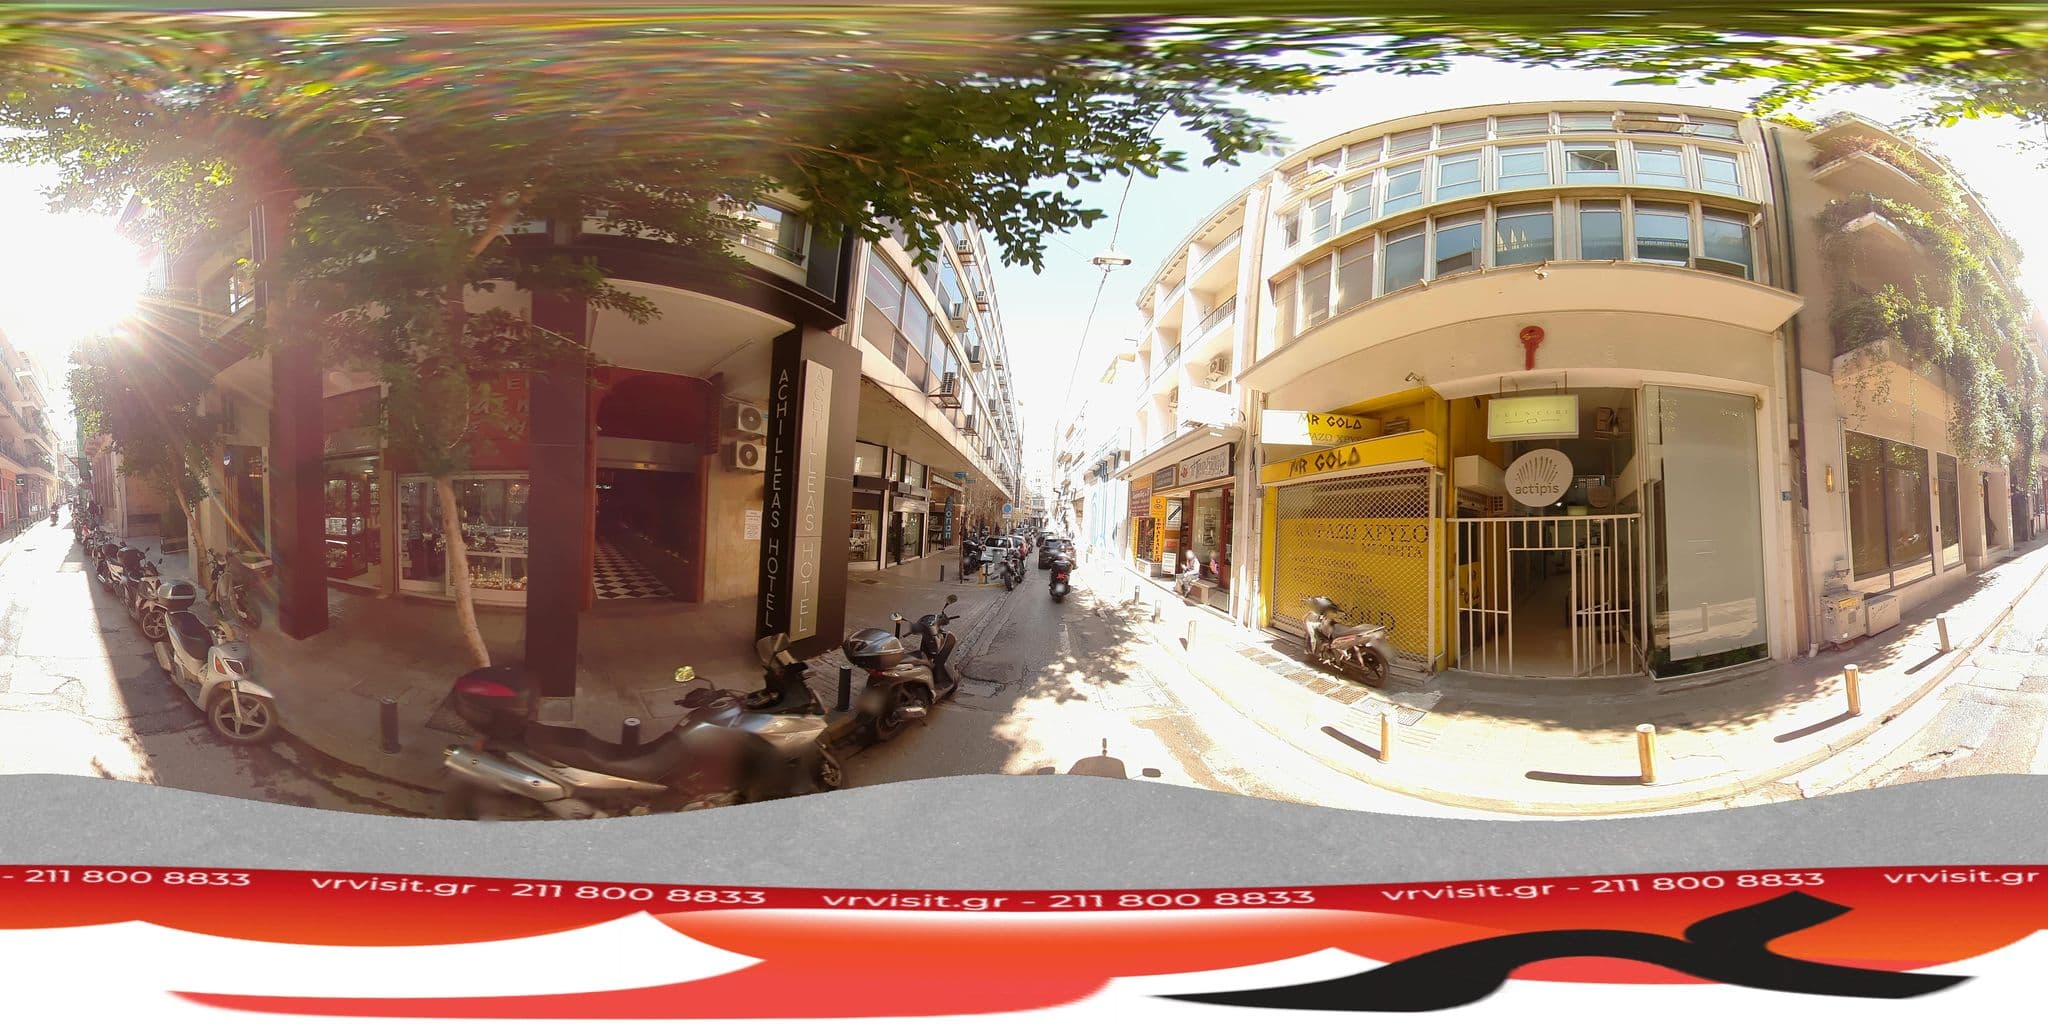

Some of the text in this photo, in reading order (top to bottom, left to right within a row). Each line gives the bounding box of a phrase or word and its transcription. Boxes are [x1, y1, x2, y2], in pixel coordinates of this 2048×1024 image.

[1289, 458, 1308, 477] MR
[765, 369, 789, 628] ACHILLEAS HOTEL
[799, 368, 826, 632] ACHILLEAS HOTEL
[1514, 483, 1560, 496] actipis
[1361, 523, 1429, 544] ΧΡΥΣΟ
